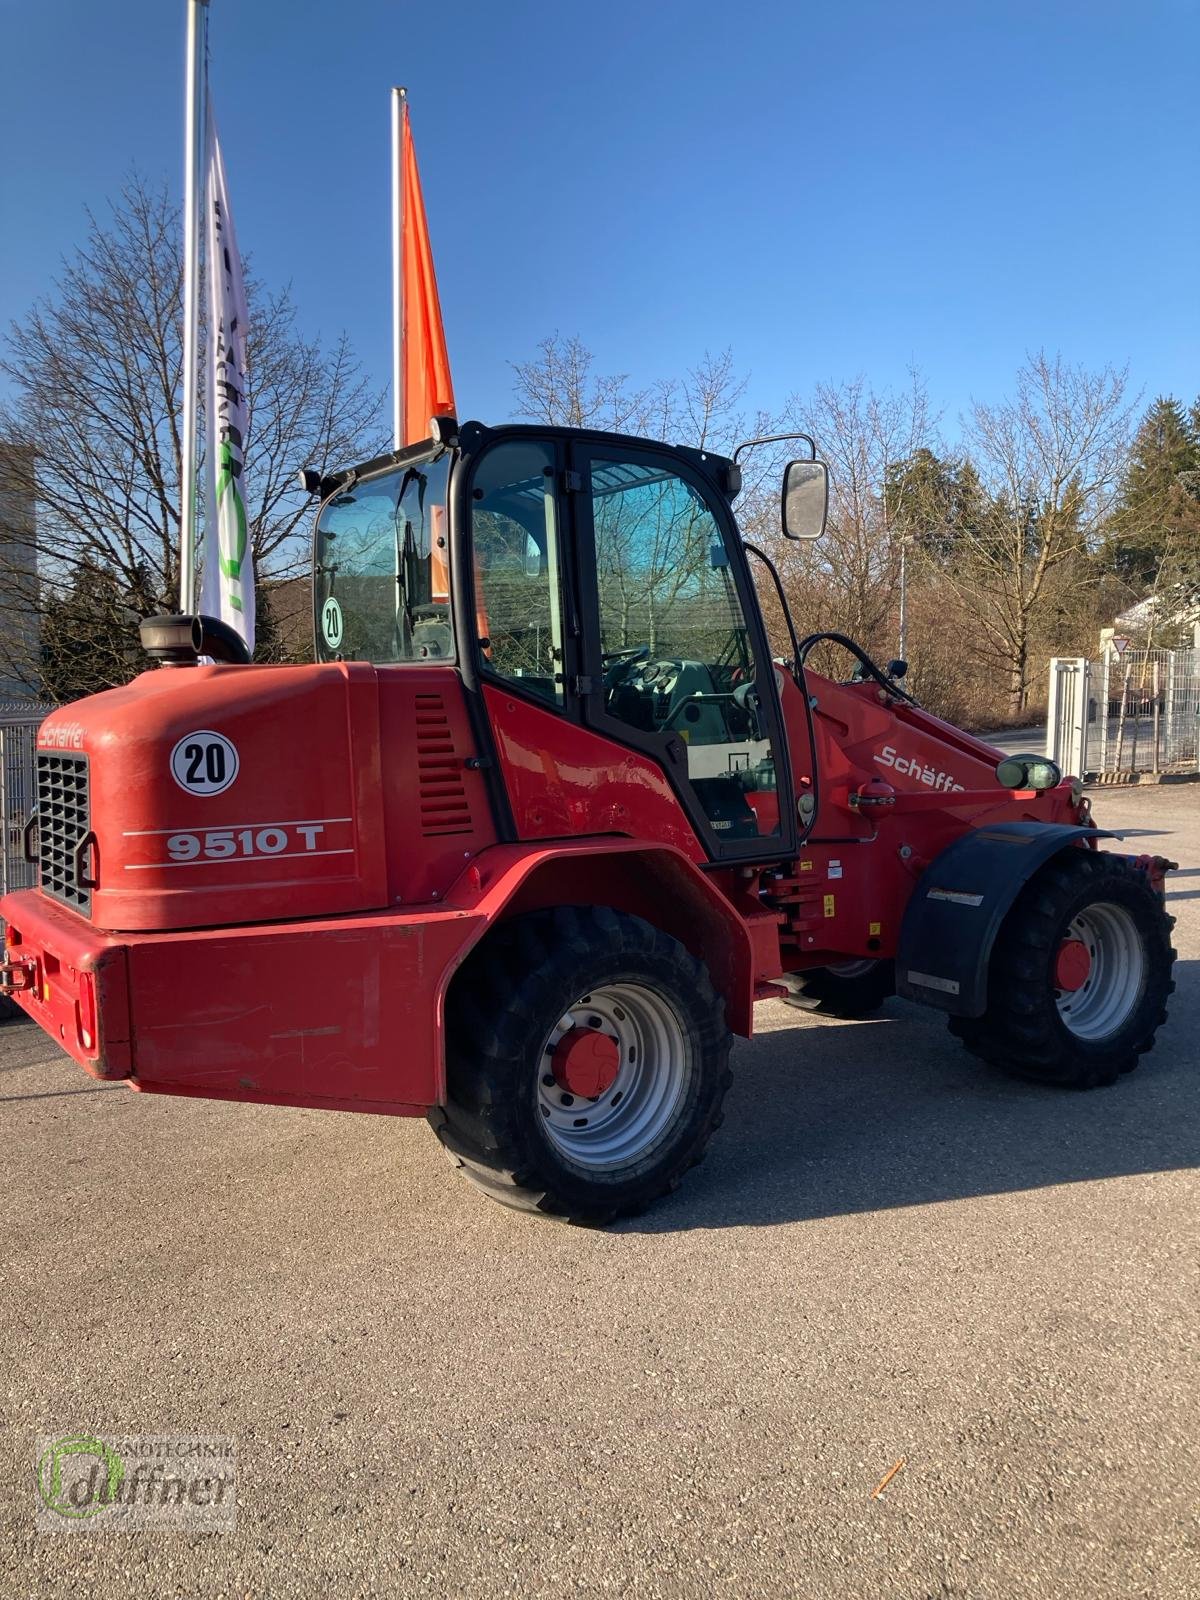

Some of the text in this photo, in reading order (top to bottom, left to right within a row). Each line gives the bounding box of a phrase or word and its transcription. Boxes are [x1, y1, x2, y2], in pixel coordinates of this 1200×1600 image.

[326, 607, 339, 638] 20
[184, 743, 226, 784] 20
[166, 825, 324, 861] 9510 T
